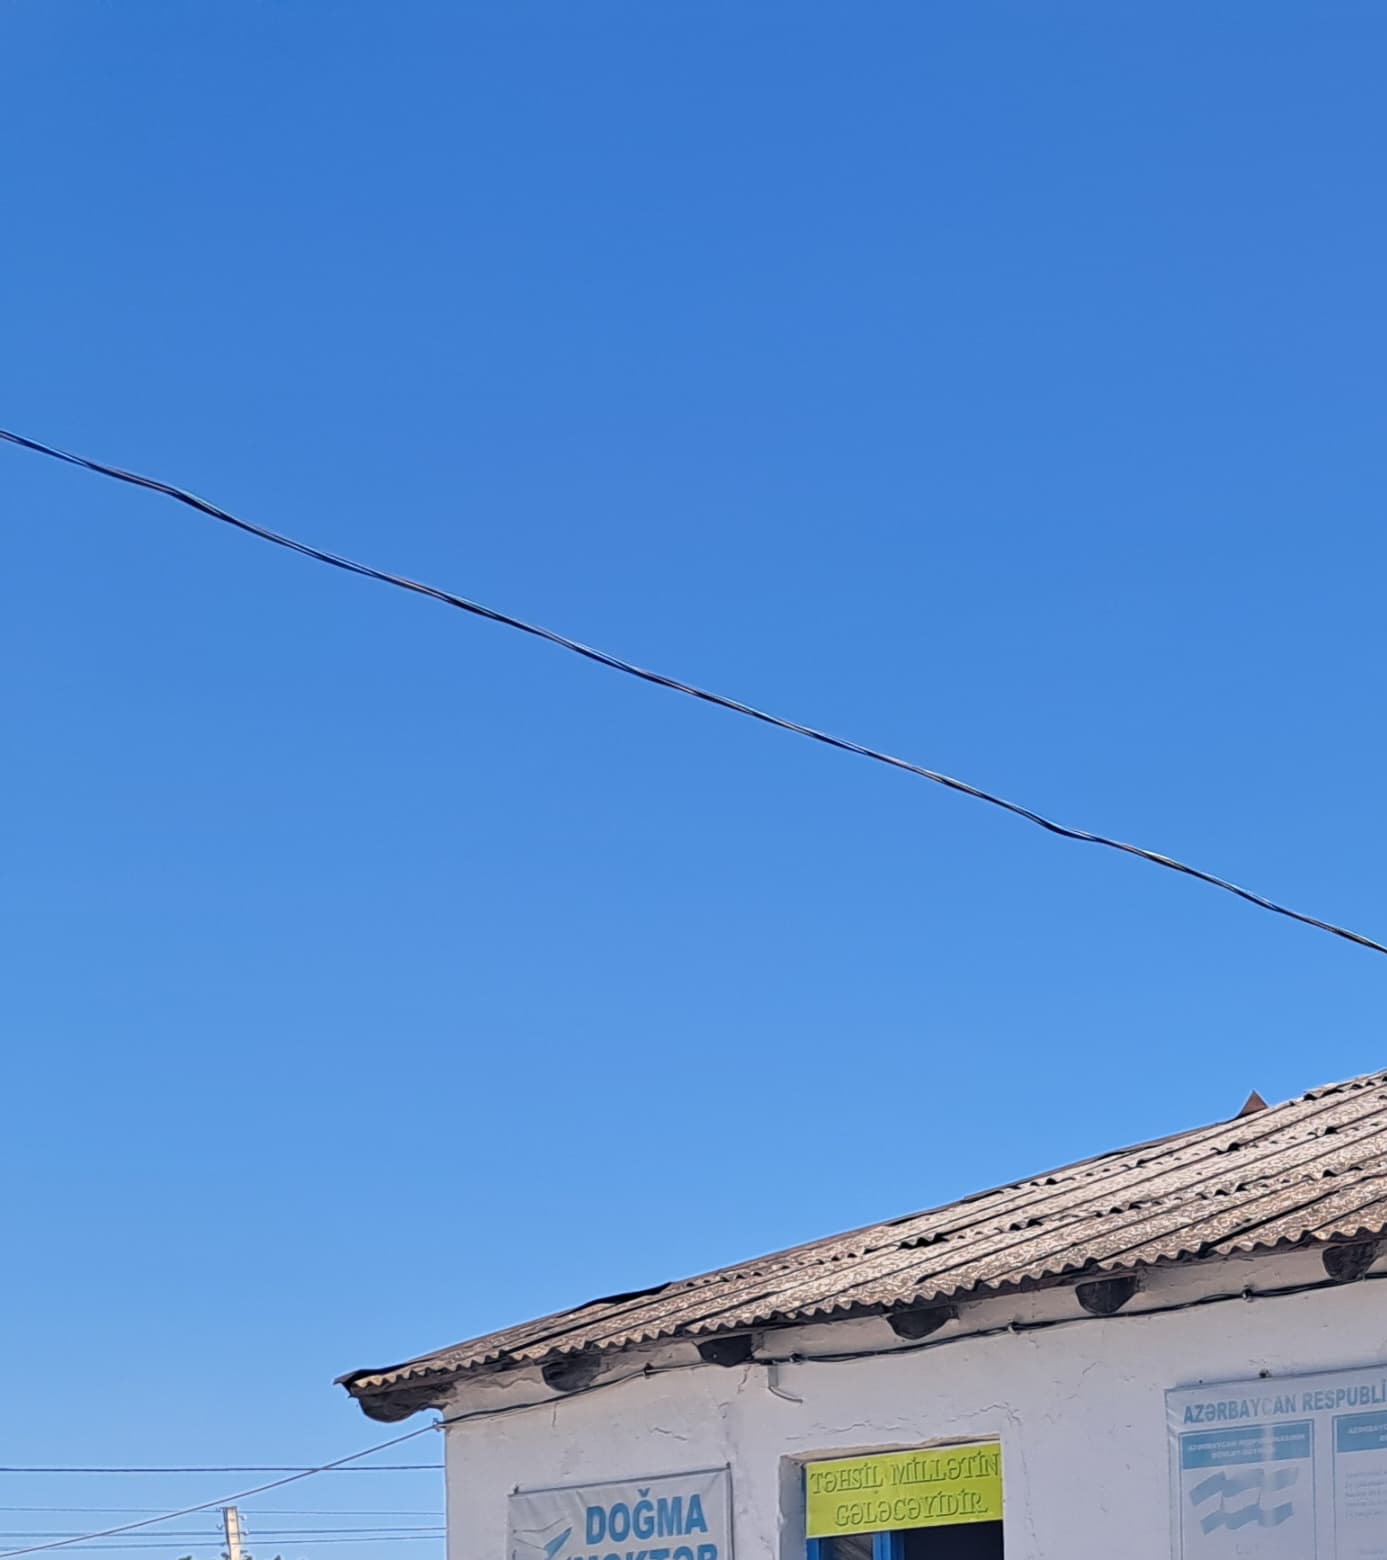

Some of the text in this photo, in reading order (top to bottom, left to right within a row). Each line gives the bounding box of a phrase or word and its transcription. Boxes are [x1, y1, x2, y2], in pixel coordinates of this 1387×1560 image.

[1183, 1398, 1297, 1425] AZƏRBAYCAN
[810, 1450, 1001, 1494] TƏHSİL MİLLƏTİN
[585, 1488, 708, 1545] DOĞMA
[835, 1488, 988, 1527] GƏLƏCƏYİDİR
